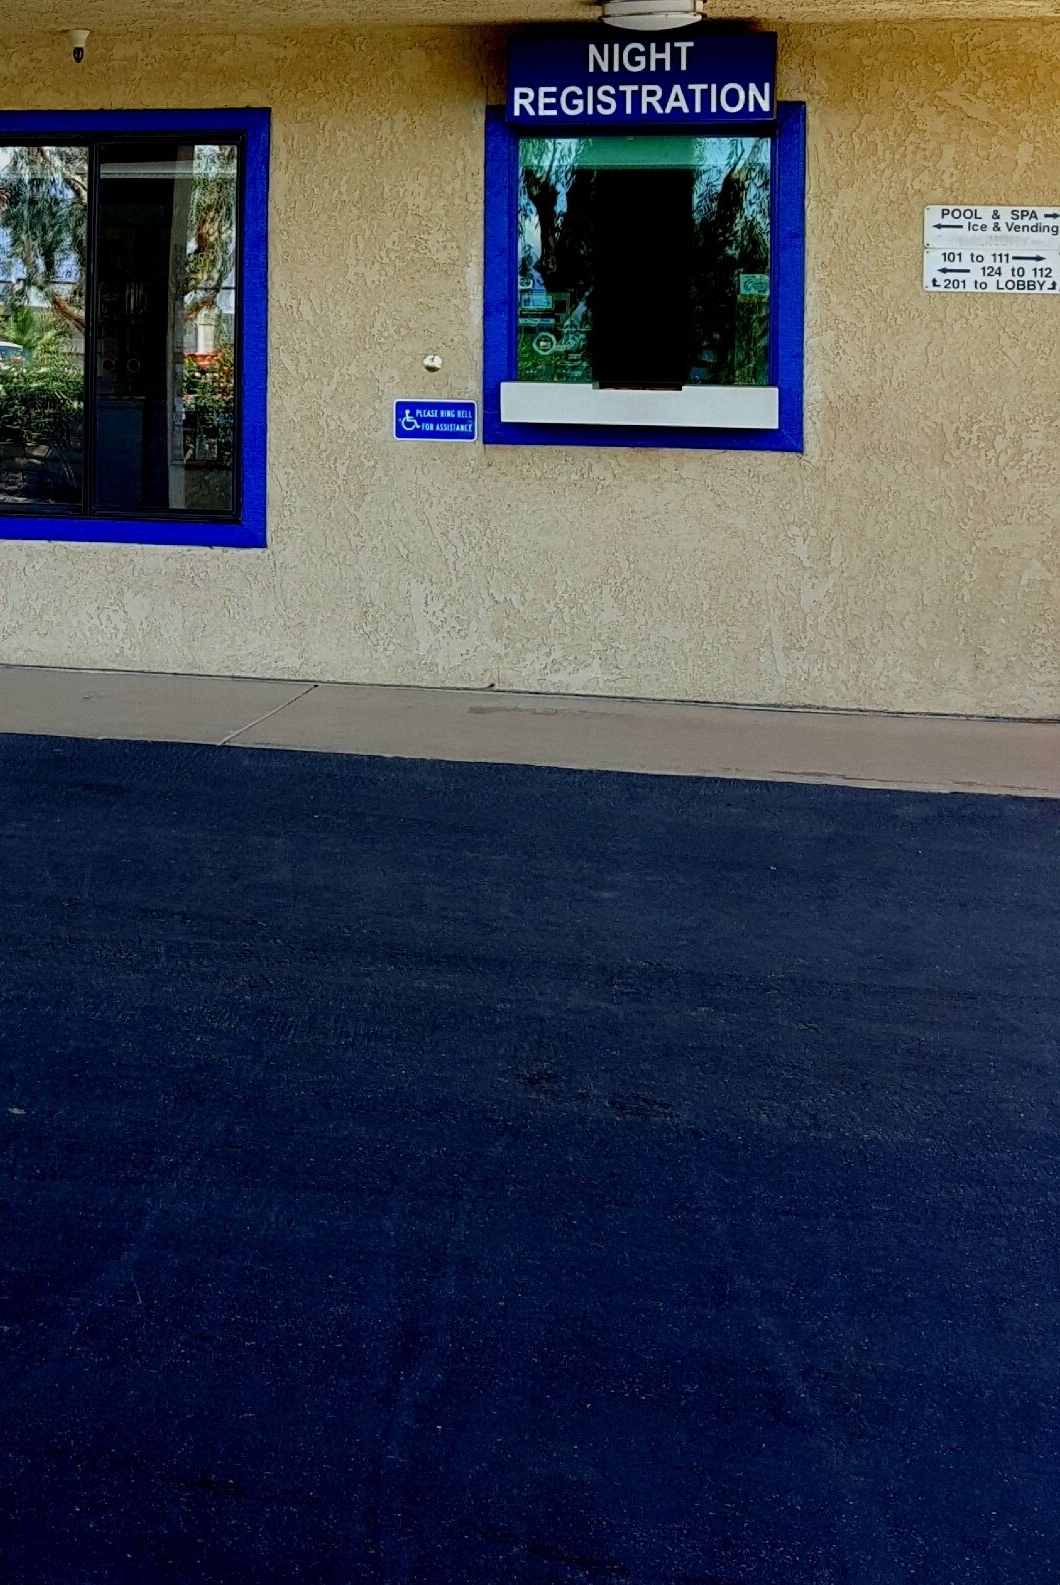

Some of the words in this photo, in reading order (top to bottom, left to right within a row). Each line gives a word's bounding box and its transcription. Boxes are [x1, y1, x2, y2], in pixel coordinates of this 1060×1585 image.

[588, 41, 694, 72] NIGHT
[513, 82, 771, 116] REGISTRATION
[941, 208, 982, 220] POOL
[991, 209, 1001, 220] &
[1010, 209, 1038, 221] SPA
[967, 221, 987, 232] Ice
[992, 222, 1001, 232] &
[1005, 222, 1059, 236] Vending
[941, 252, 962, 263] 101
[970, 252, 984, 263] to
[991, 253, 1009, 264] 111
[981, 266, 1002, 277] 124
[1032, 267, 1052, 278] 112
[943, 279, 966, 290] 201
[974, 280, 987, 290] to
[996, 279, 1046, 291] LOBBY
[415, 409, 438, 417] PLEASE
[440, 409, 455, 418] RING
[457, 409, 472, 418] BELL
[422, 422, 434, 431] FOR
[435, 423, 472, 432] ASSISTANCE
